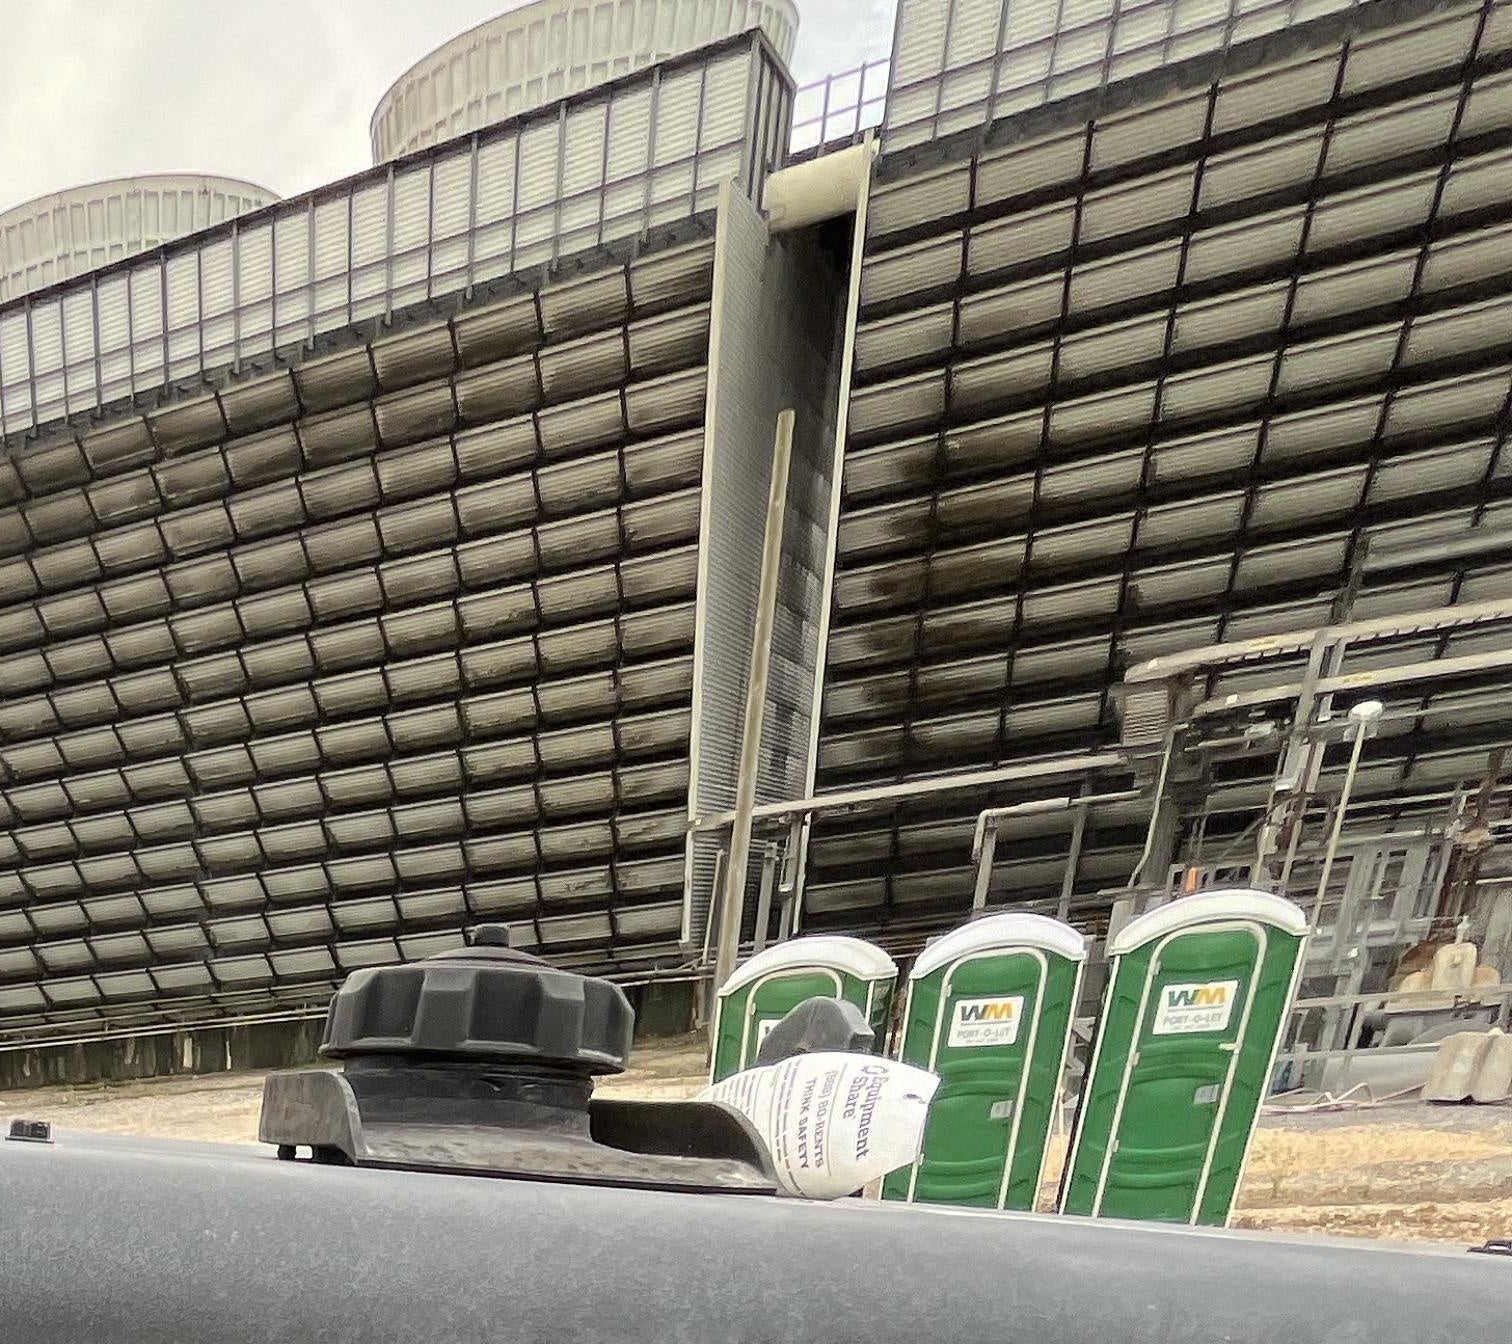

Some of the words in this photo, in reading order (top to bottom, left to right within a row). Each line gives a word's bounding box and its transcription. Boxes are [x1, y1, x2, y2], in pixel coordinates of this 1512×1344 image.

[961, 1003, 1012, 1021] WM
[1168, 987, 1225, 1007] WM
[800, 1077, 817, 1115] THINK
[843, 1076, 868, 1119] Share
[856, 1075, 889, 1161] Equipment
[798, 1116, 809, 1169] SAFETY
